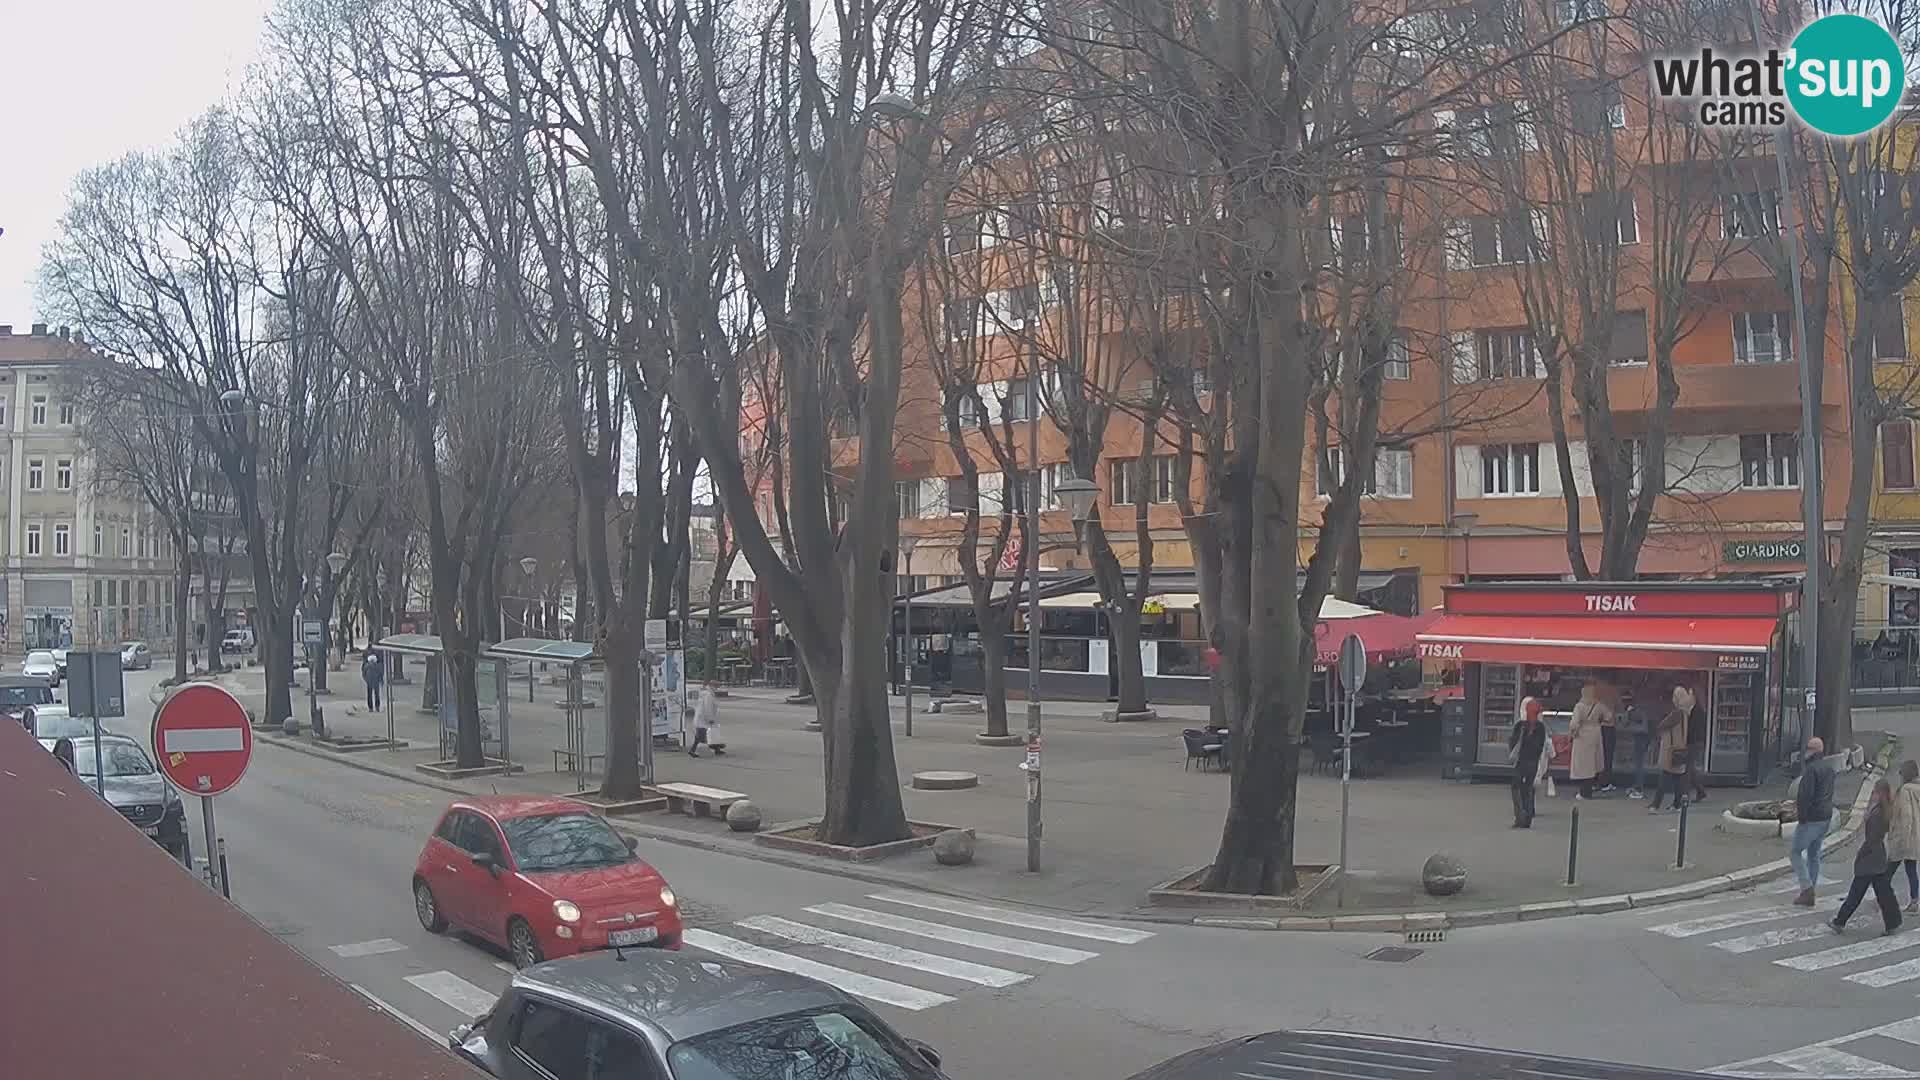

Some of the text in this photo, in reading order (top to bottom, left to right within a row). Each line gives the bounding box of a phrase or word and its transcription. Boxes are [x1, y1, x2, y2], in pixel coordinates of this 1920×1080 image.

[1735, 543, 1800, 558] GIARDINO
[1585, 595, 1636, 611] TISAK
[1419, 643, 1463, 658] TISAK
